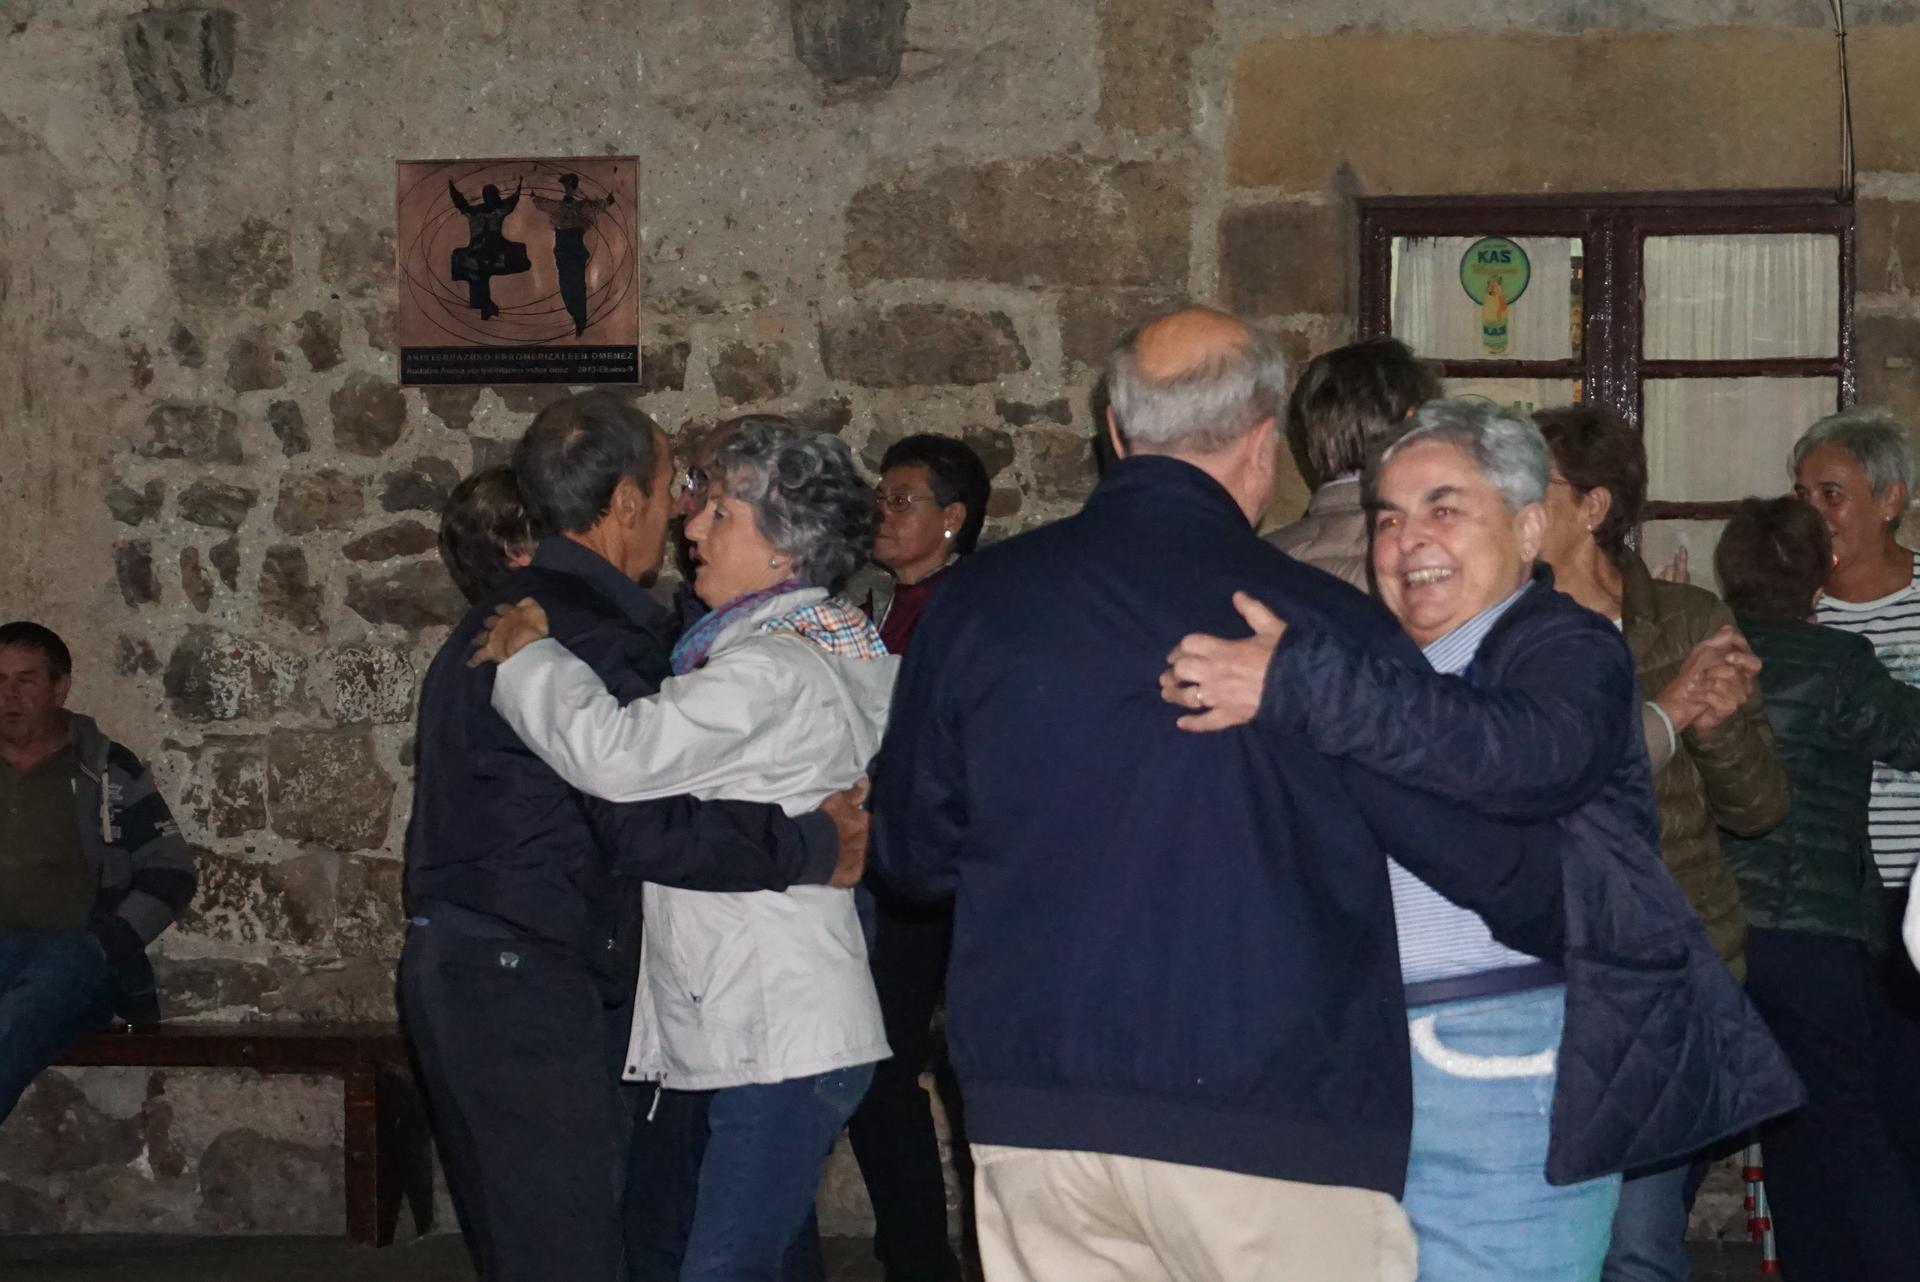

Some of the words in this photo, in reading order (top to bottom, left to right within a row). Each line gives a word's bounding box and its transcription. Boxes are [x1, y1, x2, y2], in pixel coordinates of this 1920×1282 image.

[1478, 250, 1512, 264] KAS
[1483, 325, 1508, 336] KAS
[591, 352, 633, 360] OMENEZ
